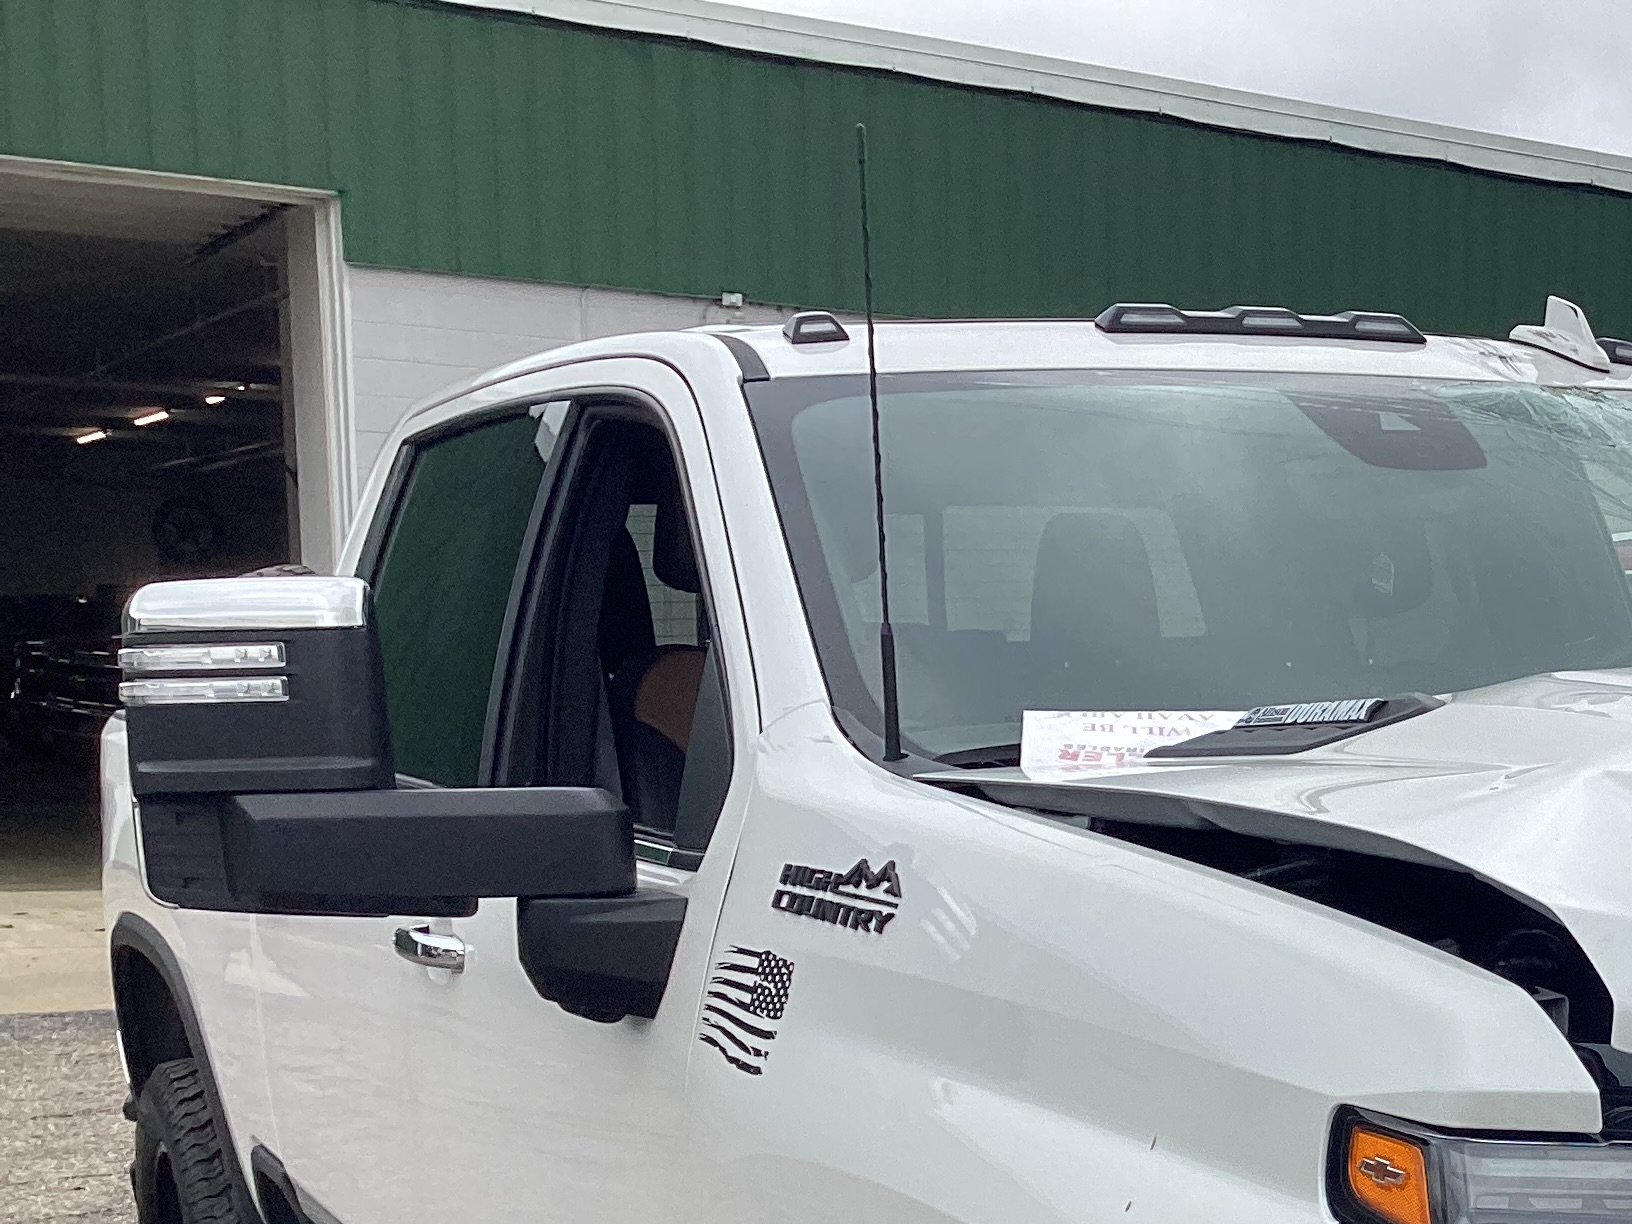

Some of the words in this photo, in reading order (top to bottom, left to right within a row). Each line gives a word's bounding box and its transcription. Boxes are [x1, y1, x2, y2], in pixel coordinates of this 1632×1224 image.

[1284, 698, 1384, 724] DURAMAX
[1082, 722, 1115, 733] BE
[1124, 725, 1192, 737] WILL
[778, 863, 846, 892] HIGH
[771, 889, 896, 935] COUNTRY
